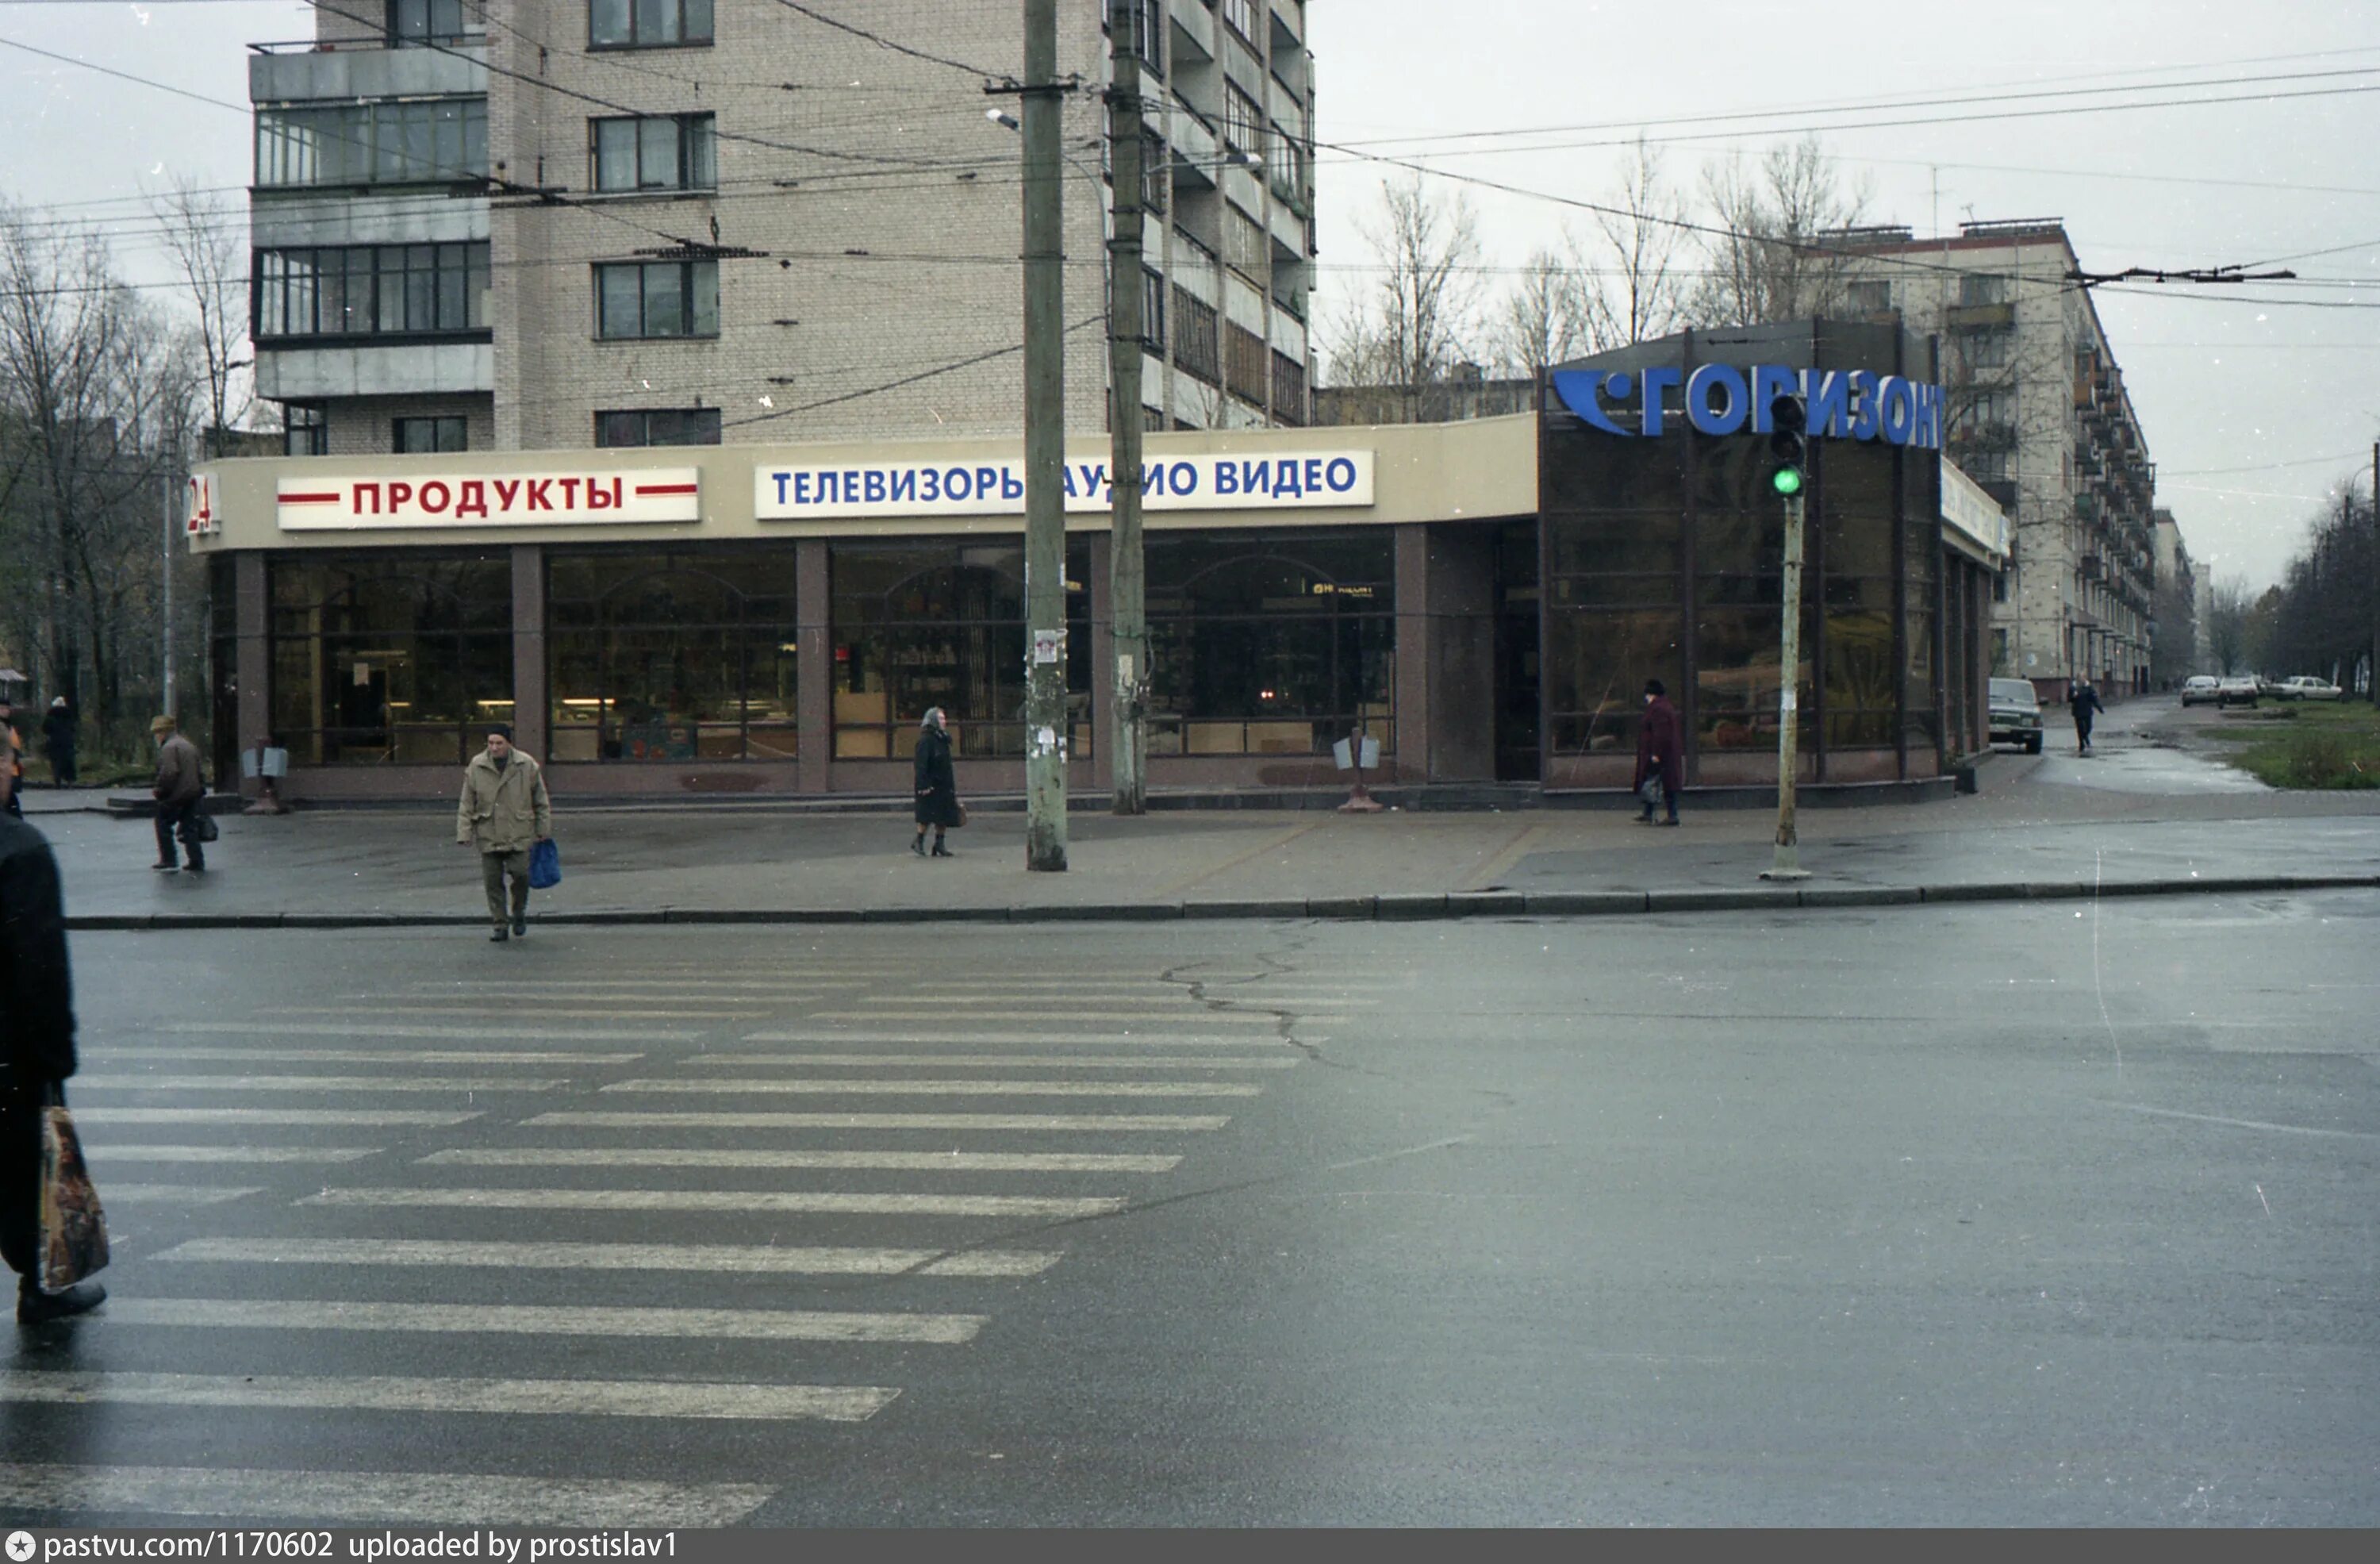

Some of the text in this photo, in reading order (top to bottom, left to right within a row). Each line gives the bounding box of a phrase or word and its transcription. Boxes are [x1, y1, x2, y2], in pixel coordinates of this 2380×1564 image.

[351, 476, 623, 519] ПРОДУКТЫ
[1064, 460, 1200, 503] АУИО
[1215, 457, 1357, 499] ВИДЕО
[188, 477, 210, 531] 24
